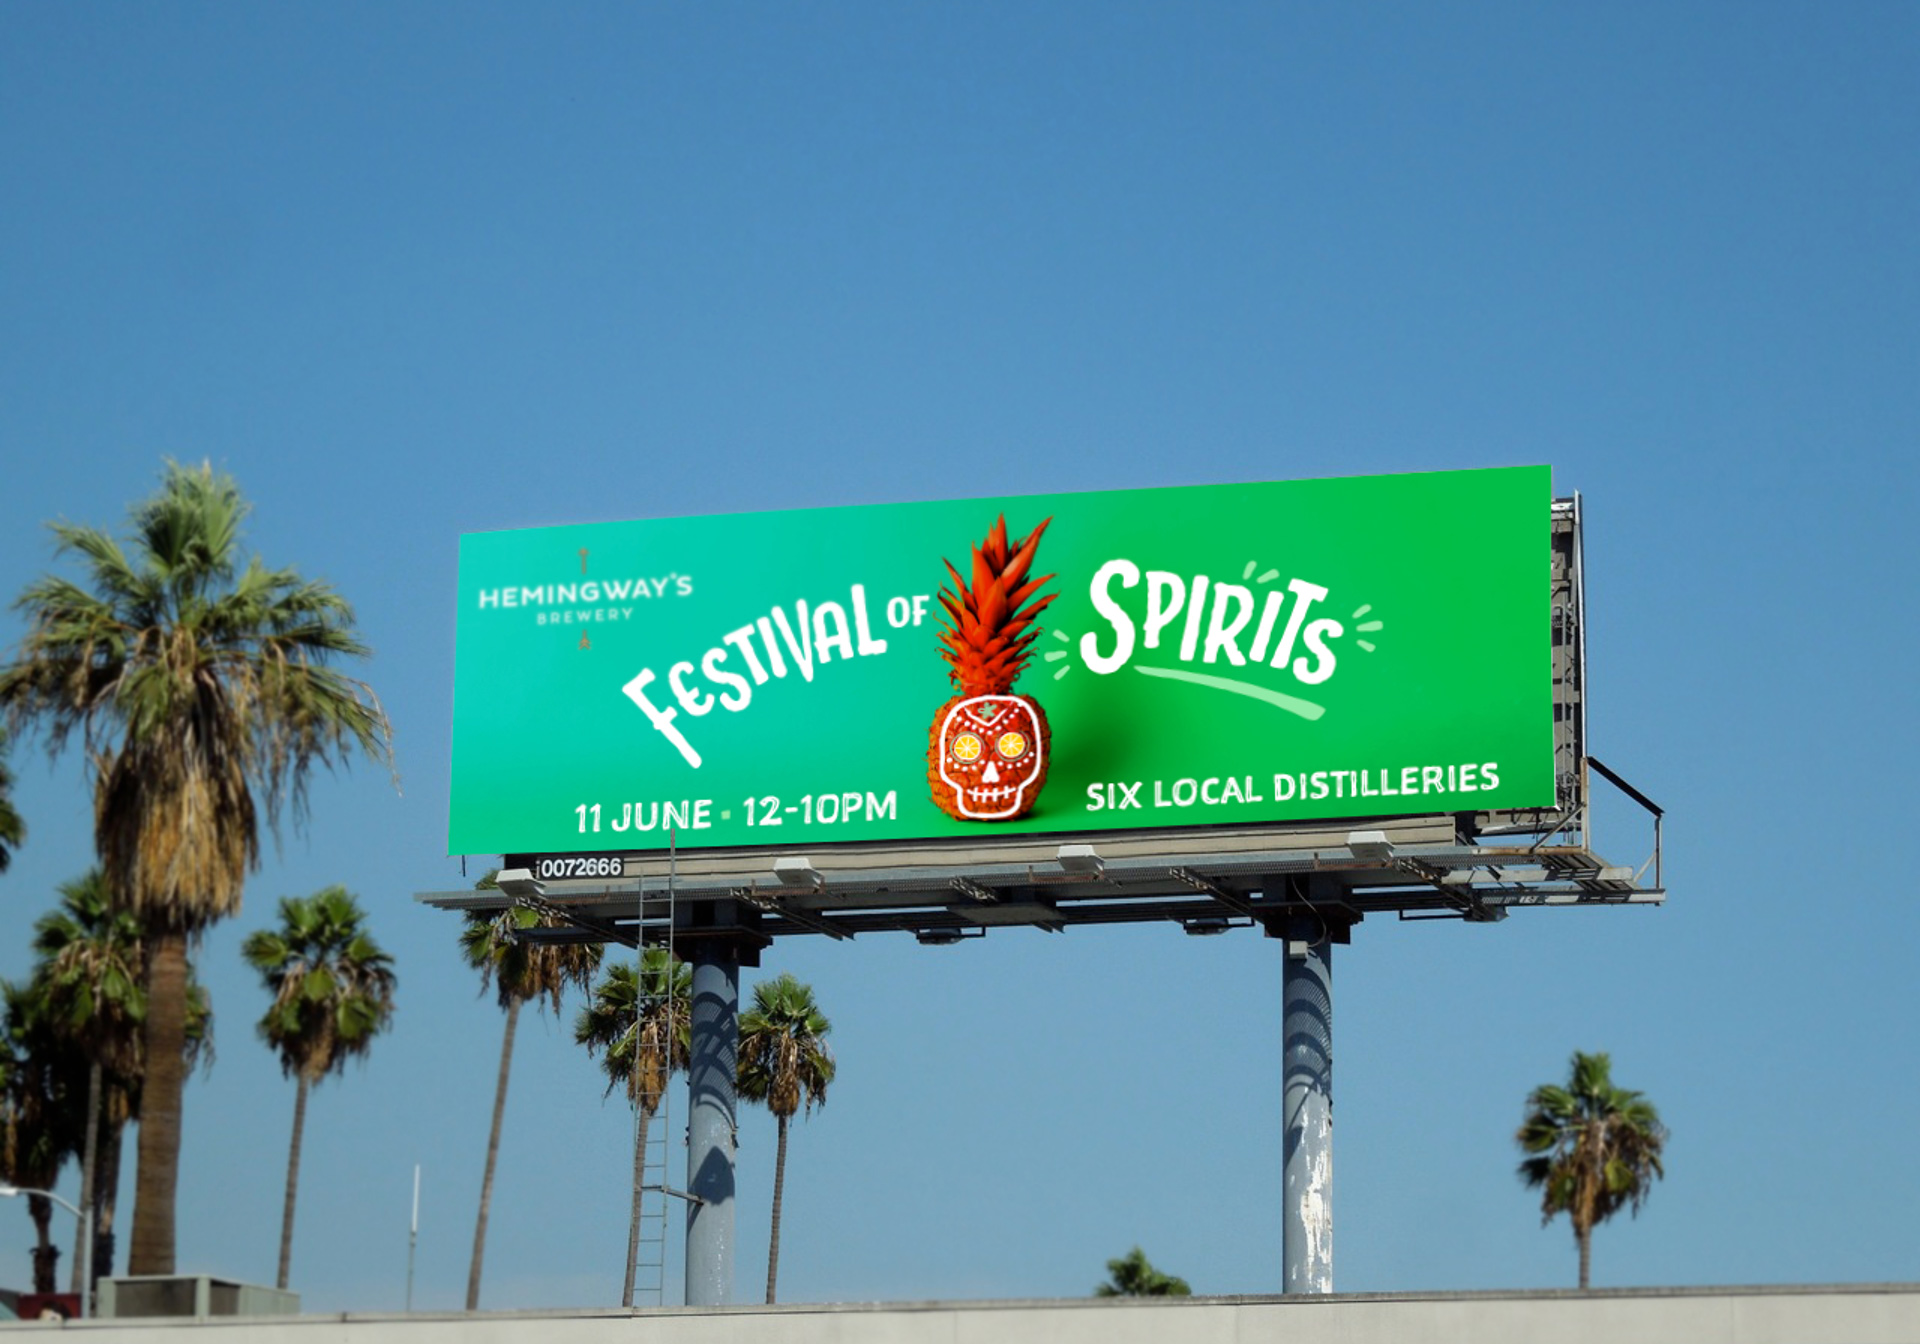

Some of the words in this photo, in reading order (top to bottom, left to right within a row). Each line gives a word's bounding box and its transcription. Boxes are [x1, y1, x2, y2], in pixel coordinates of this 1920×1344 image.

[478, 573, 694, 609] HEMINGWAY'S
[536, 607, 633, 625] BREWERY
[622, 583, 888, 769] FESTIVAL
[886, 595, 930, 628] OF
[1080, 559, 1344, 685] SPIRITS
[1086, 781, 1143, 811] SIX
[1154, 775, 1263, 808] LOCAL
[1275, 762, 1500, 802] DISTILLERIES
[575, 803, 601, 833] 11
[611, 799, 712, 831] JUNE
[743, 790, 897, 826] 12-10PM
[540, 857, 622, 878] 0072666
